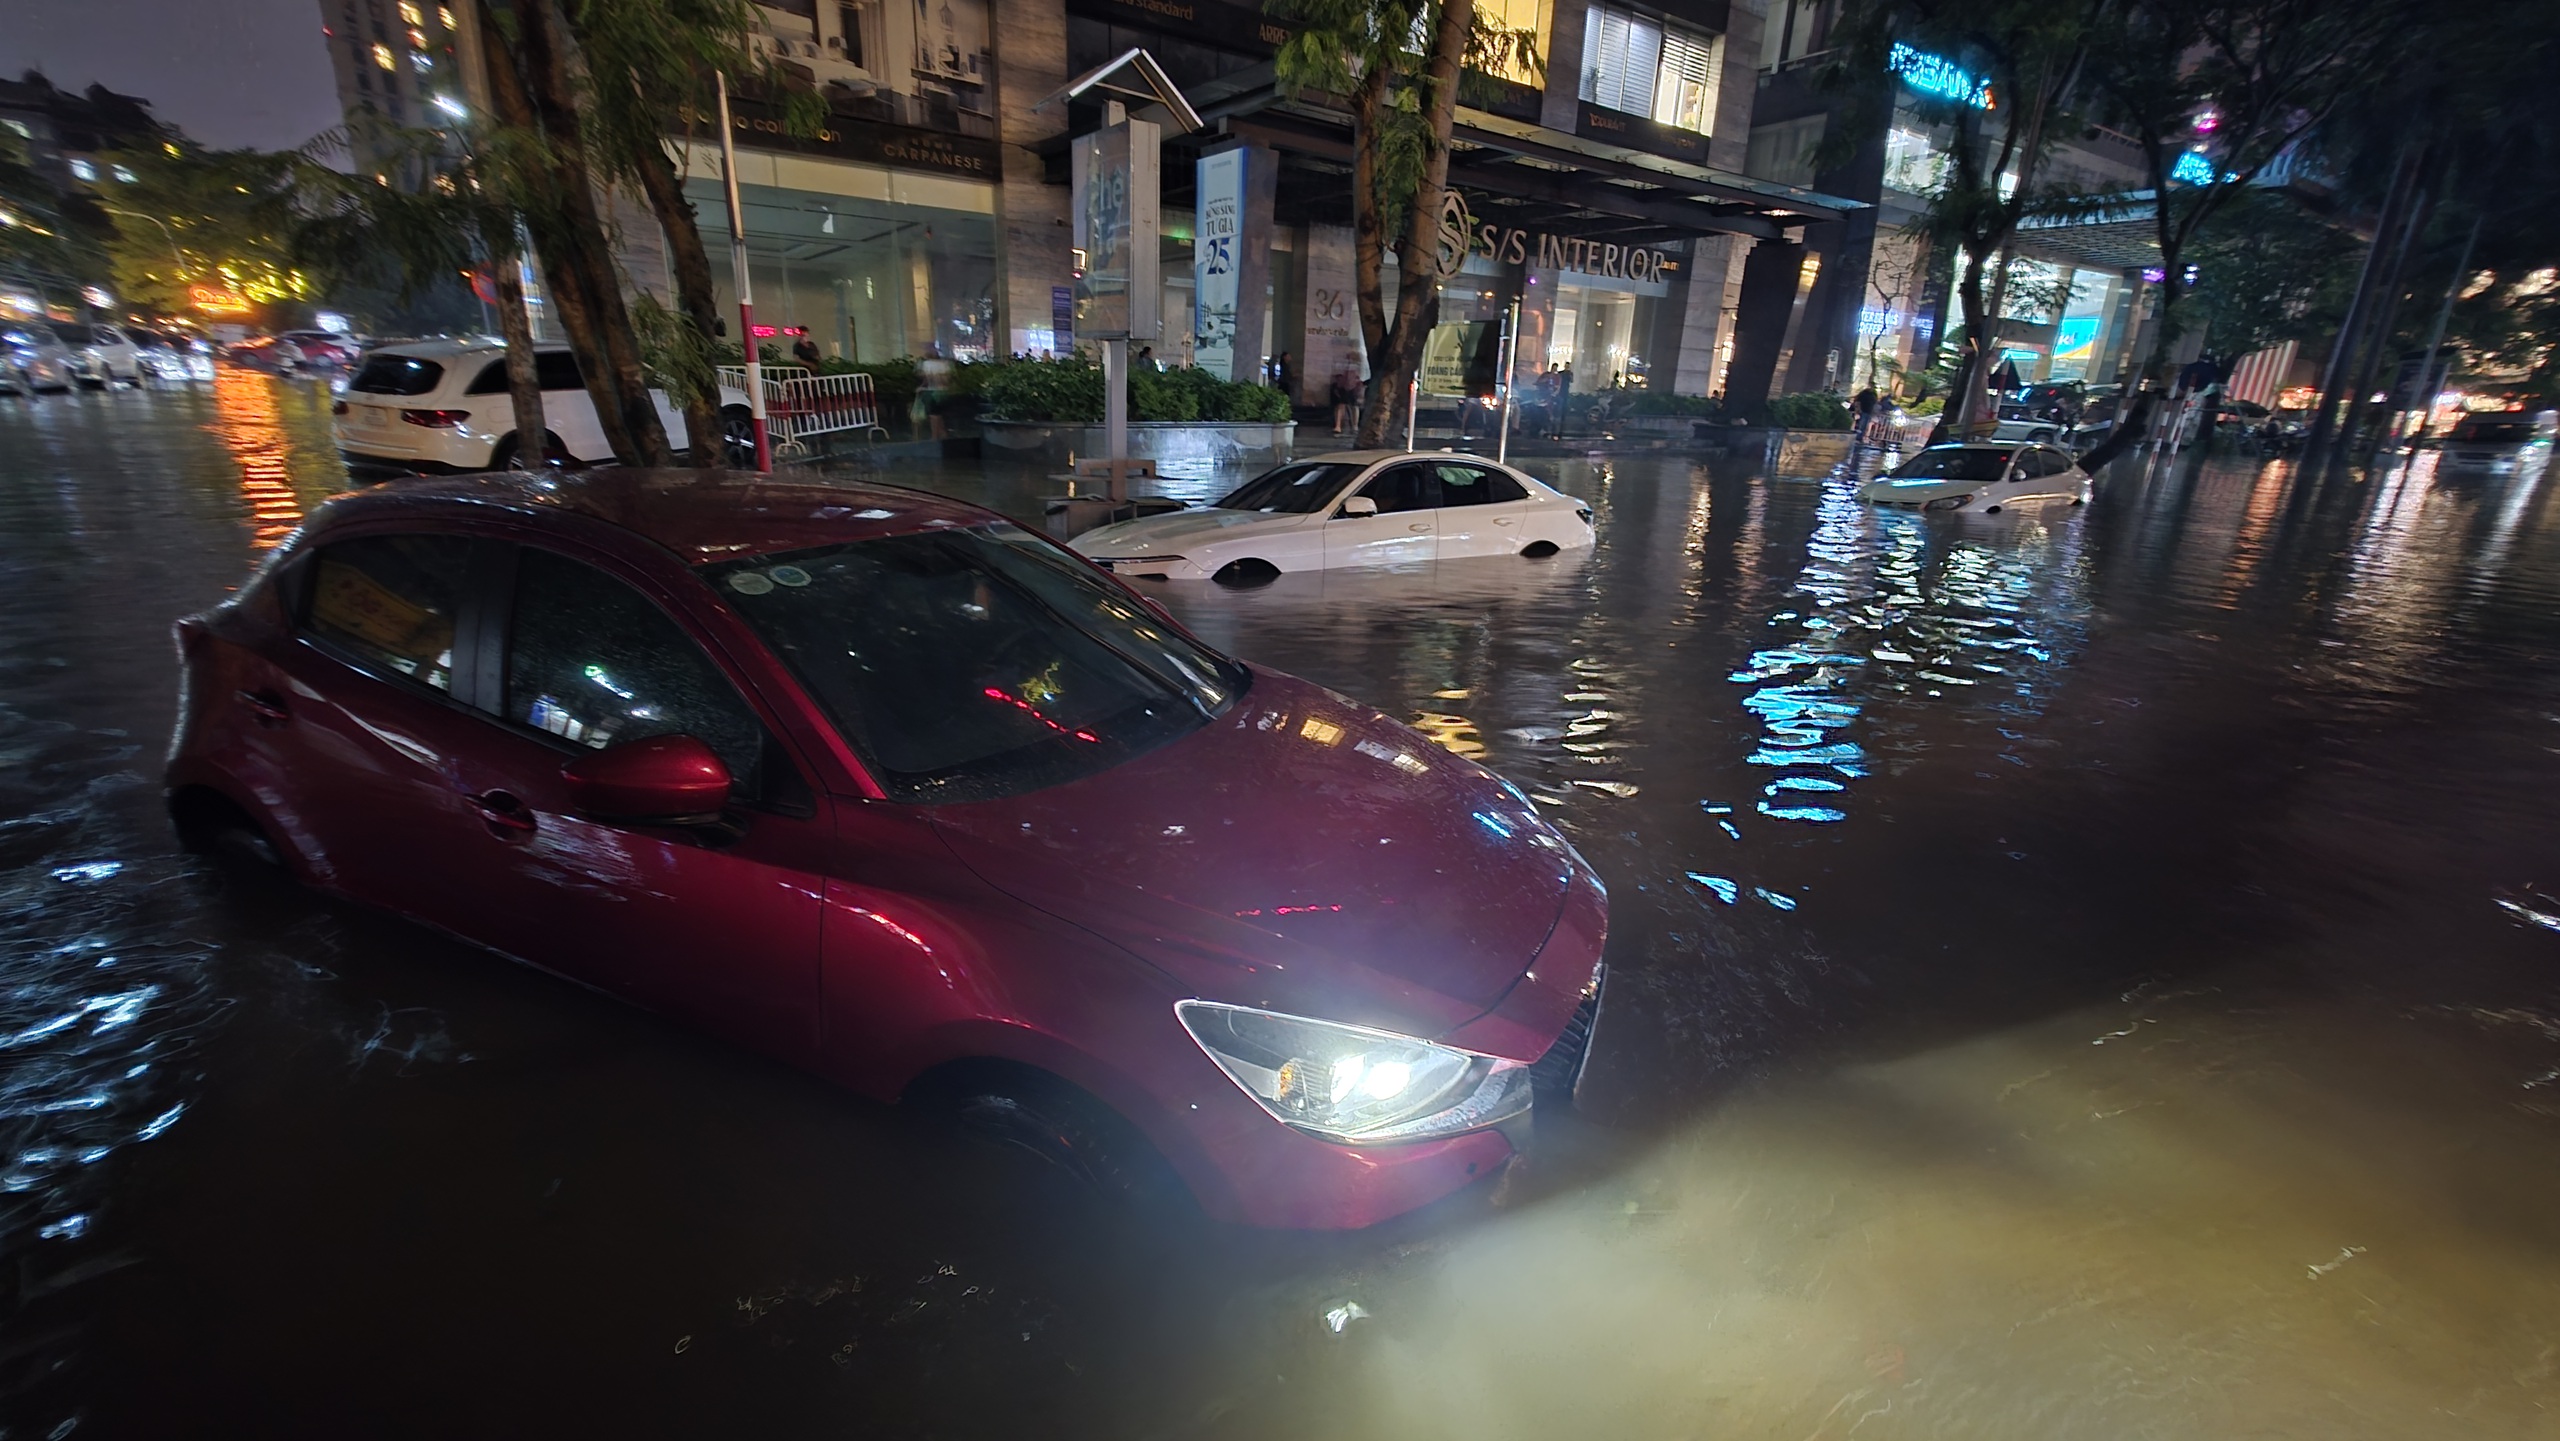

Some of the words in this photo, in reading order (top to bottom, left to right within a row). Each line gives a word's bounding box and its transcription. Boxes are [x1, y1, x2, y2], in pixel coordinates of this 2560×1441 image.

[883, 143, 982, 171] CARPANESE
[1480, 224, 1528, 265] S/S
[1538, 232, 1666, 284] INTERIOR
[1314, 288, 1345, 321] 36
